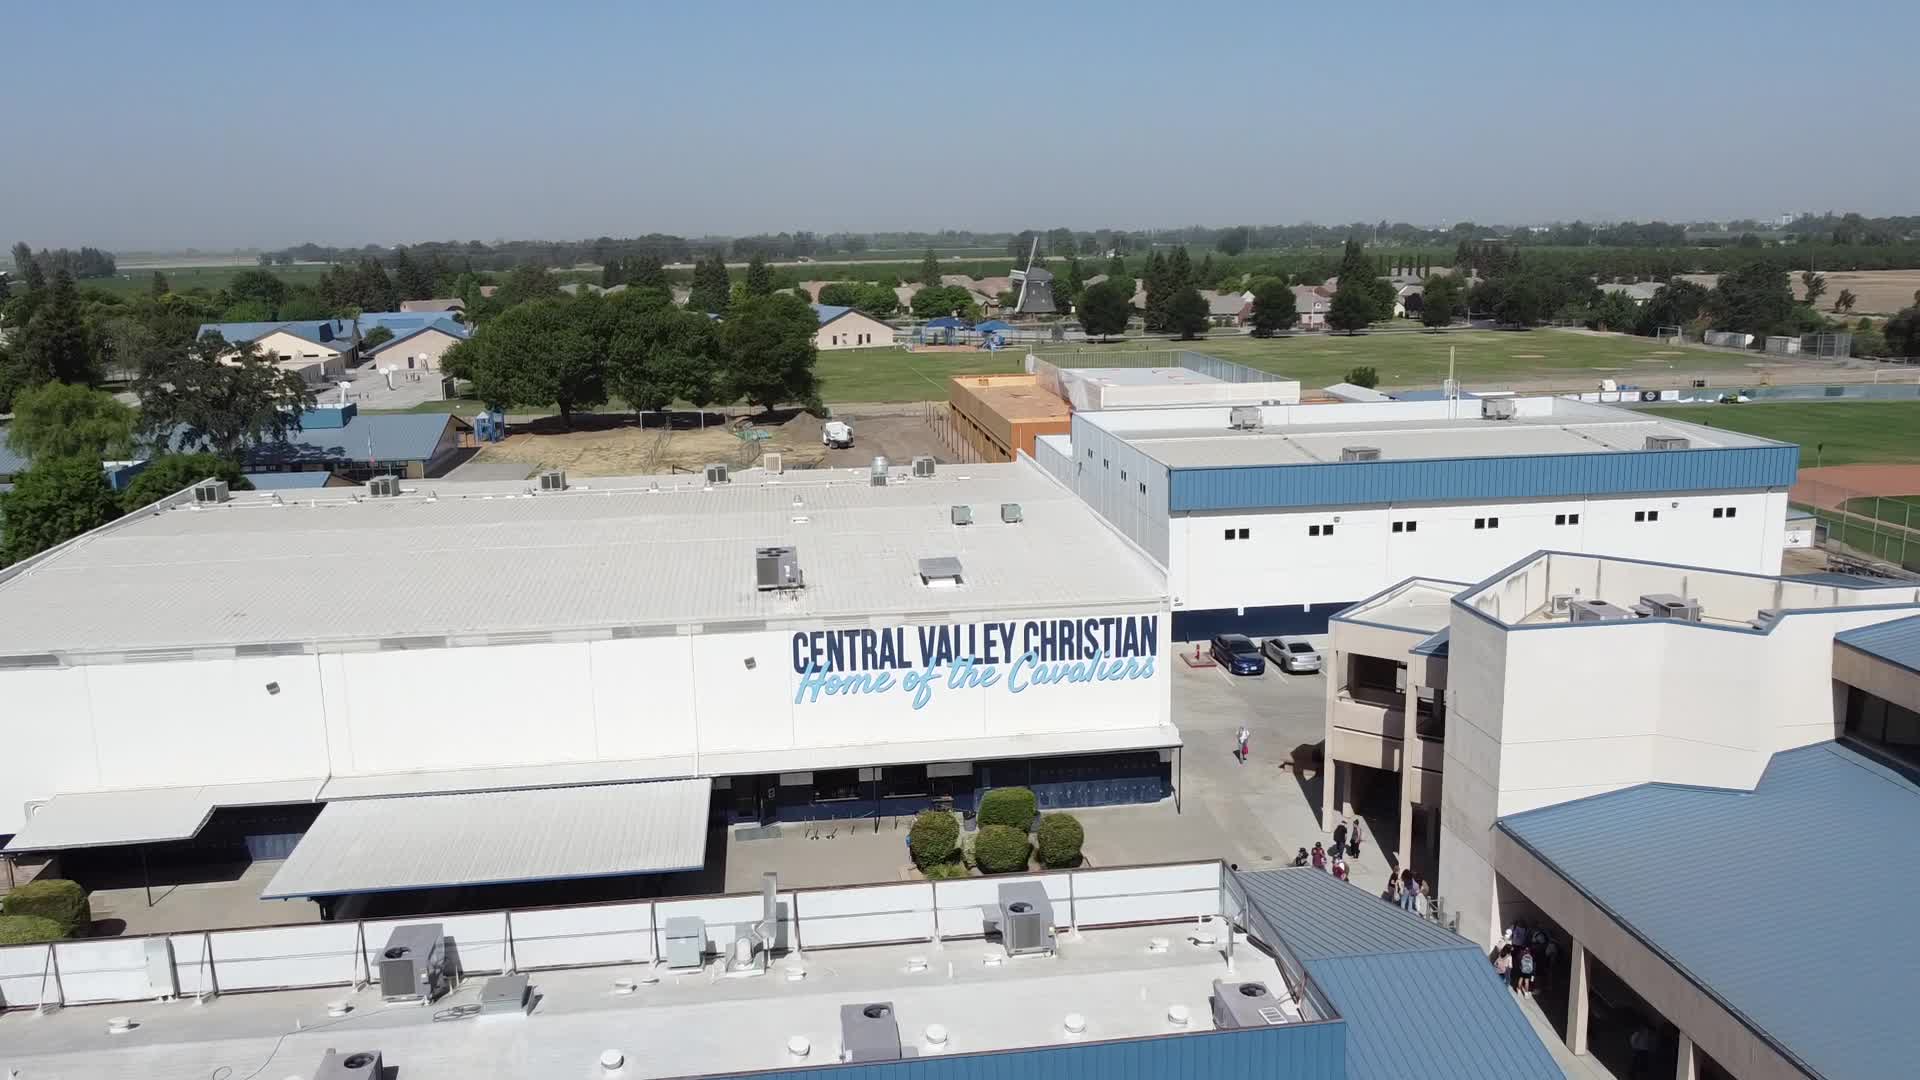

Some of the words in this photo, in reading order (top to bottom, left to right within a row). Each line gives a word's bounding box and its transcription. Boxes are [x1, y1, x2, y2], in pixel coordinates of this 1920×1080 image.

[792, 627, 912, 674] CENTRAL
[918, 622, 1016, 668] VALLEY
[1023, 615, 1158, 662] CHRISTIAN
[794, 660, 897, 705] Home
[903, 655, 942, 710] of
[947, 653, 1001, 690] the
[1007, 648, 1154, 693] Cavaliers
